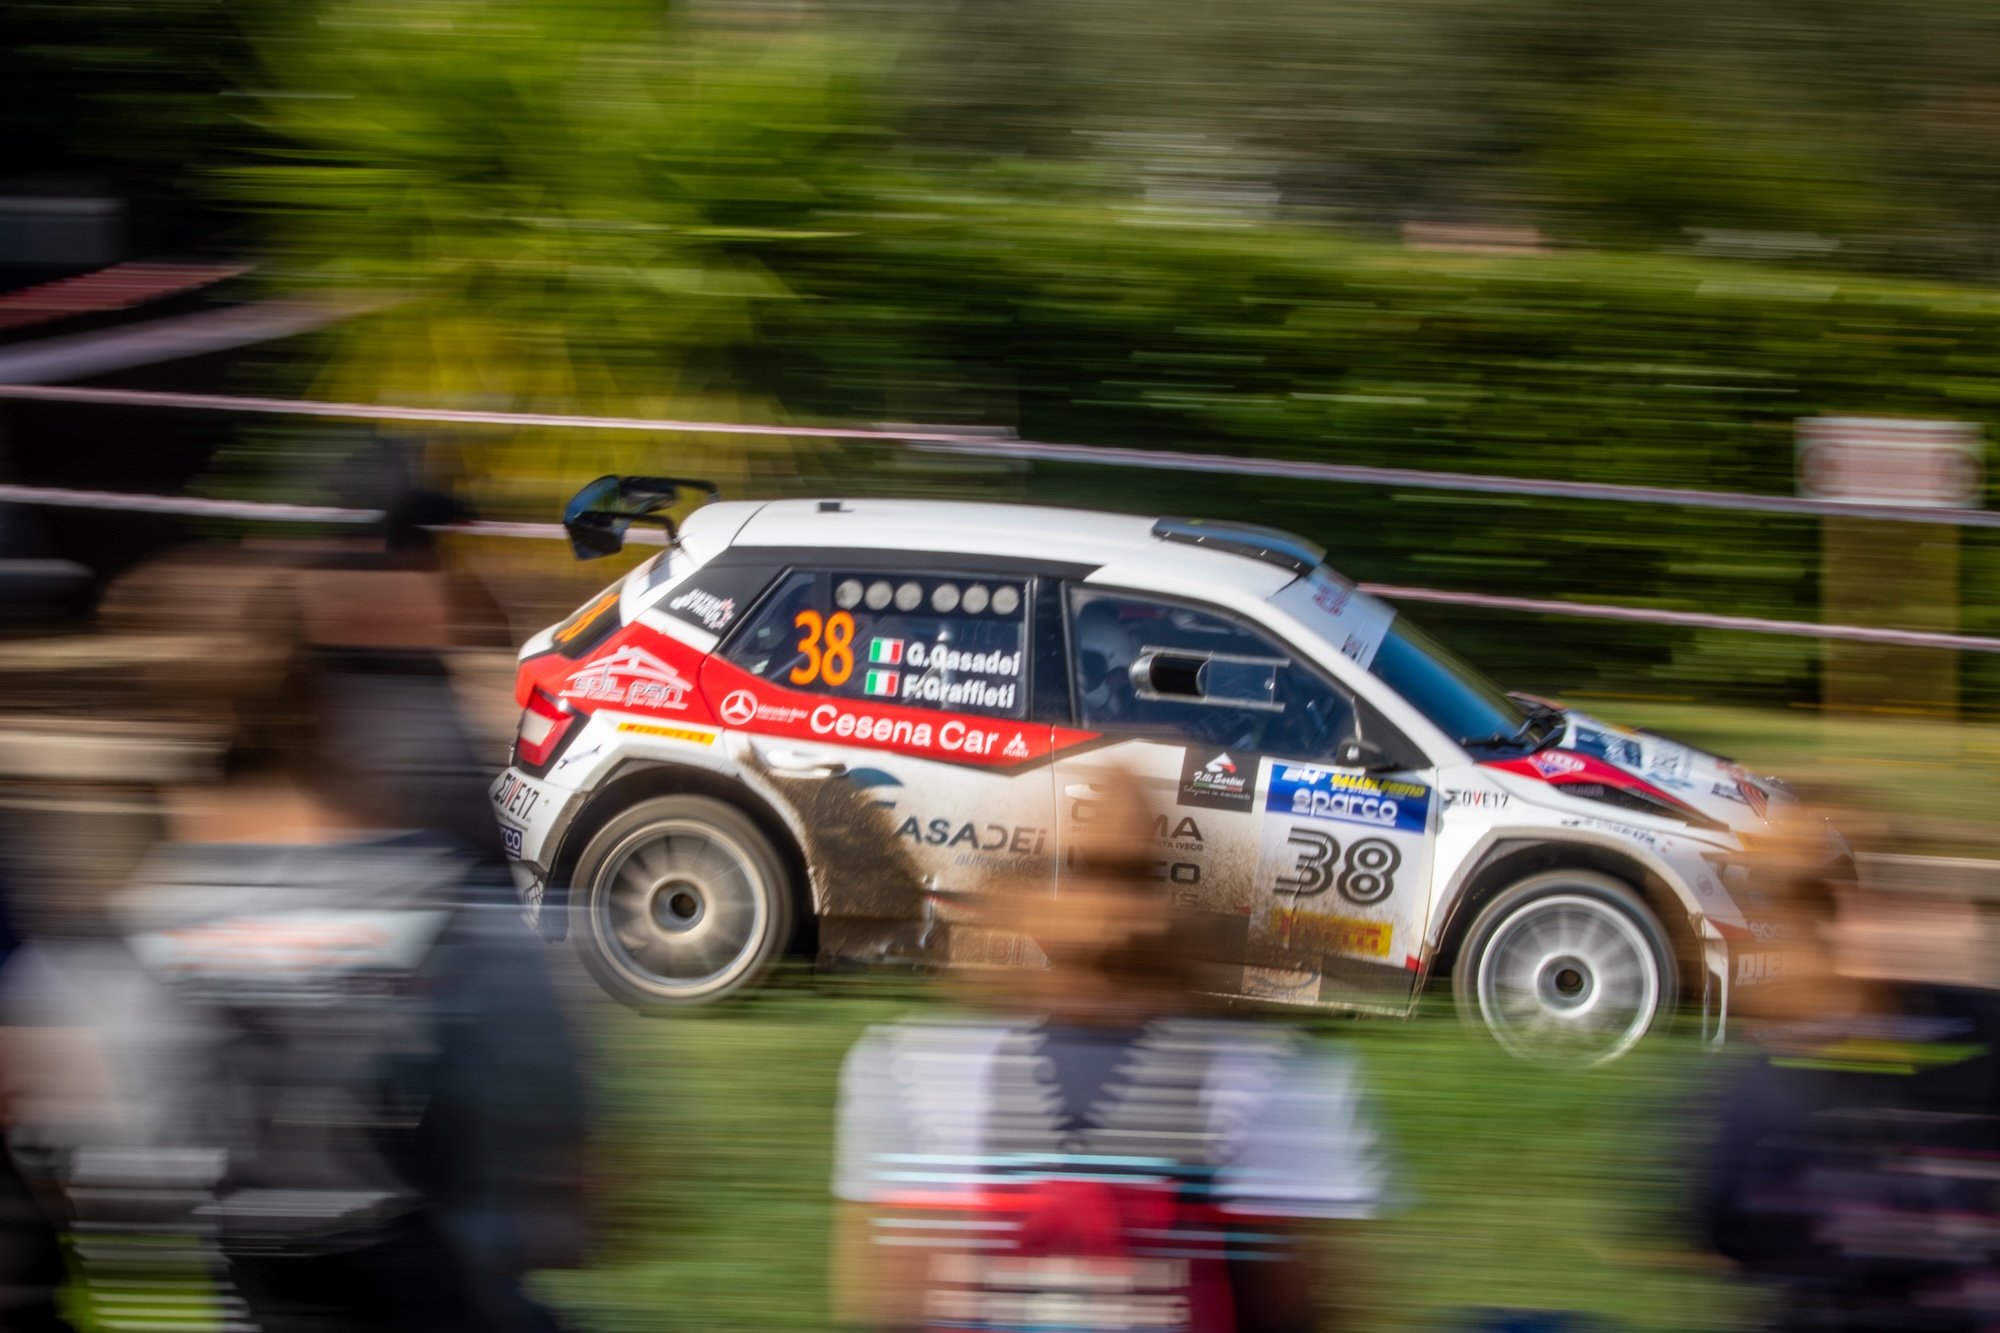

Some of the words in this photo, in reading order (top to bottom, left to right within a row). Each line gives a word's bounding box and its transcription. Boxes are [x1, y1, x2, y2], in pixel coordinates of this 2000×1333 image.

[789, 609, 856, 687] 38
[810, 704, 932, 747] Cesena
[939, 720, 999, 755] Car
[1292, 787, 1398, 824] sparco
[1273, 825, 1402, 905] 38
